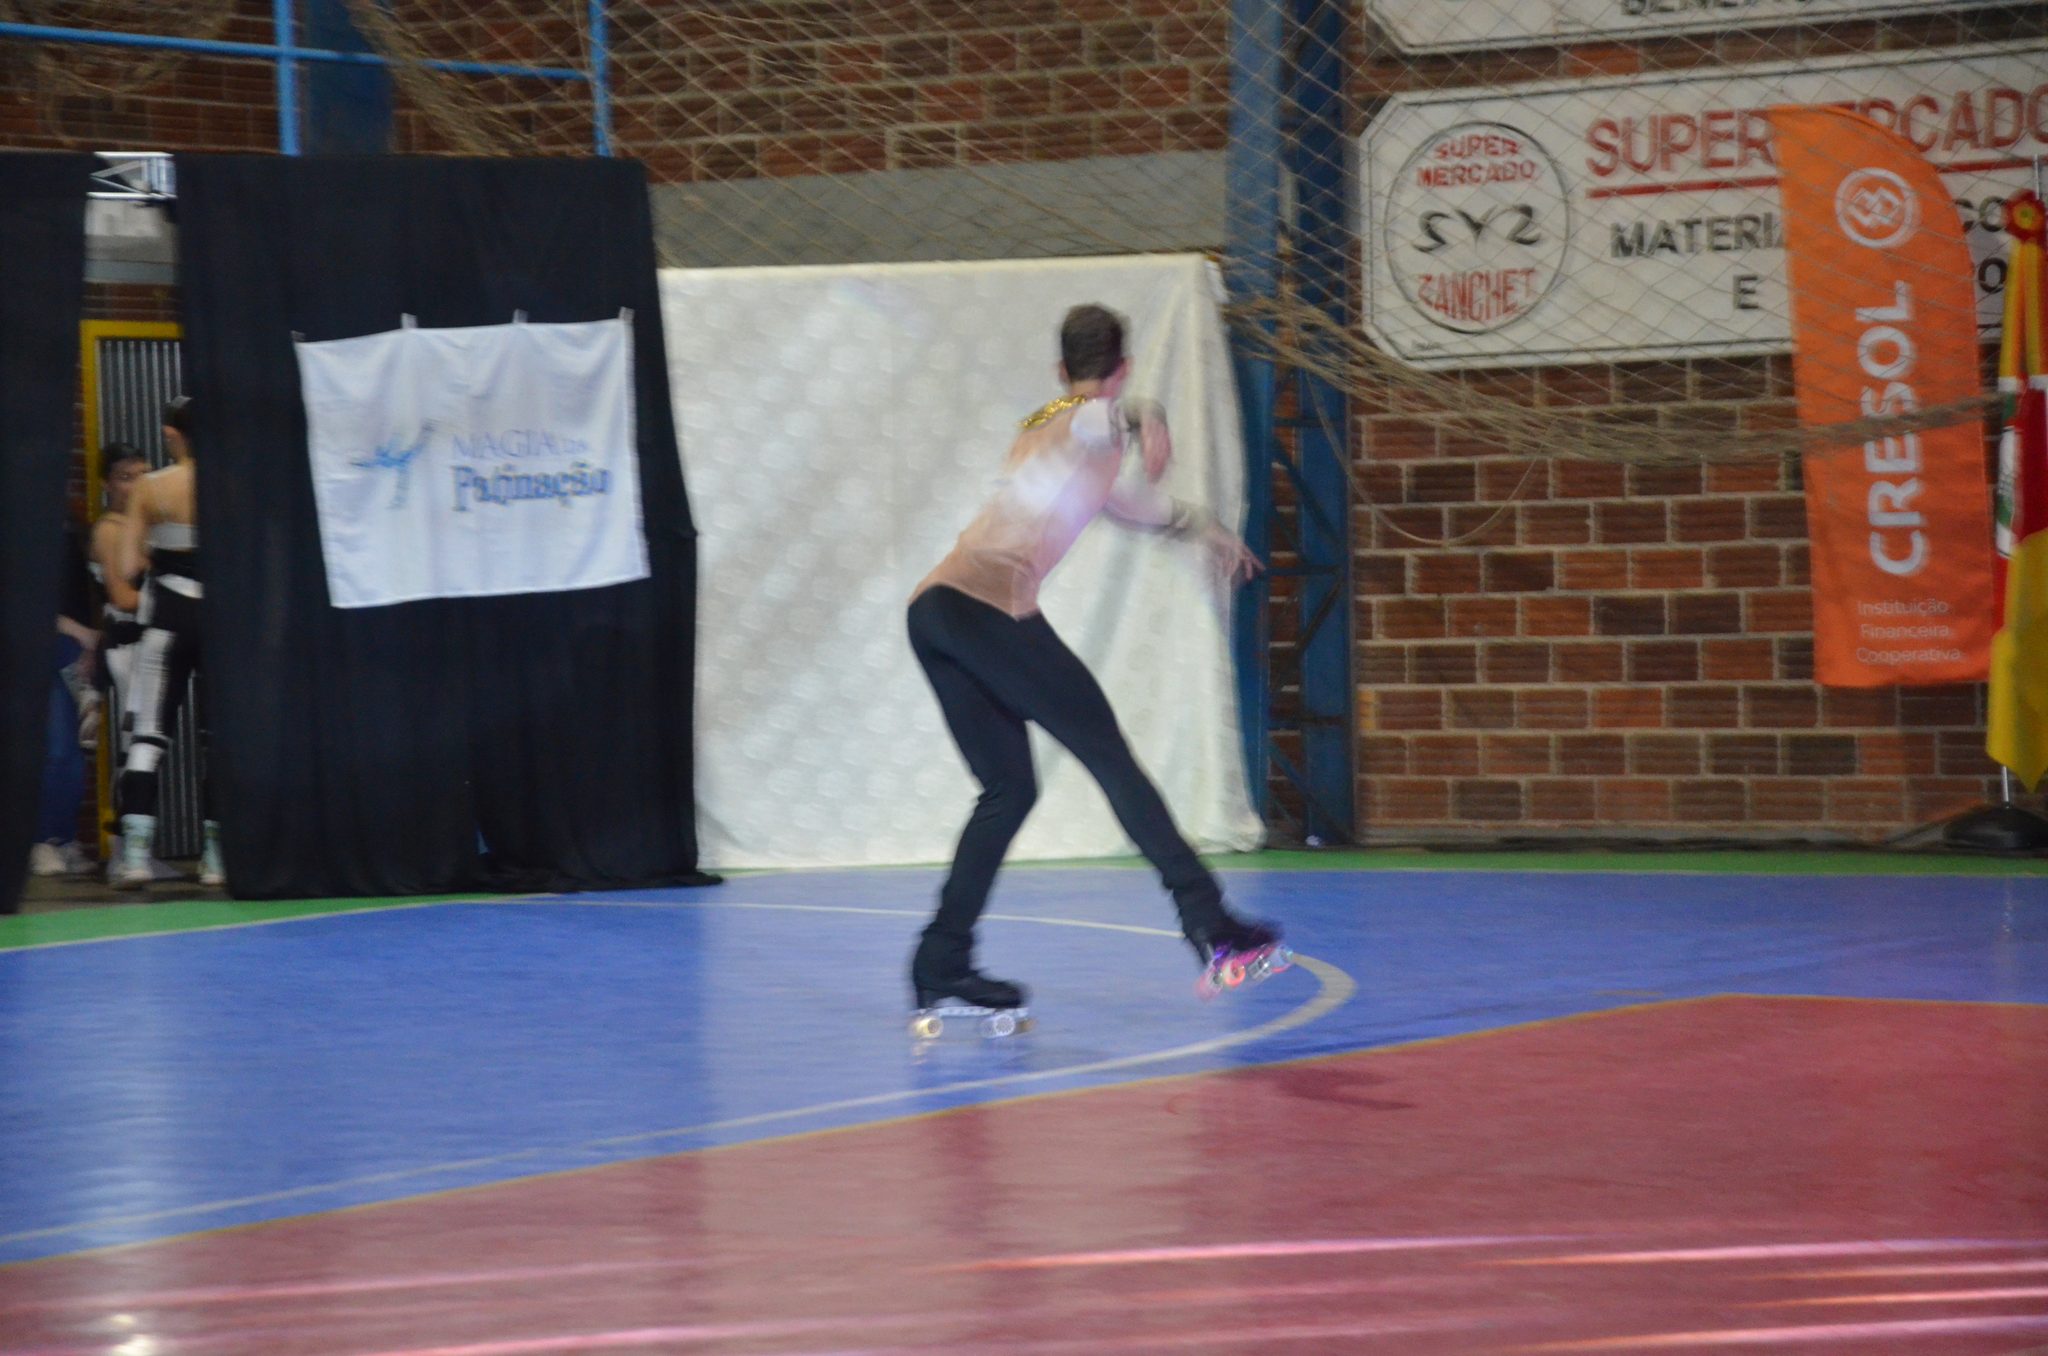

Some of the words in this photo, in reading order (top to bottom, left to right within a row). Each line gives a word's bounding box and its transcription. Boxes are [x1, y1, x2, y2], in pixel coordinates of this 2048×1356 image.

[1434, 134, 1521, 160] SUPER
[1416, 159, 1537, 188] MERCADO
[1417, 267, 1538, 321] ZANCHET
[1855, 279, 1927, 576] CRESOL
[1857, 599, 1949, 617] Instituição
[1860, 621, 1951, 640] Financeira
[1855, 647, 1963, 667] Cooperativa
